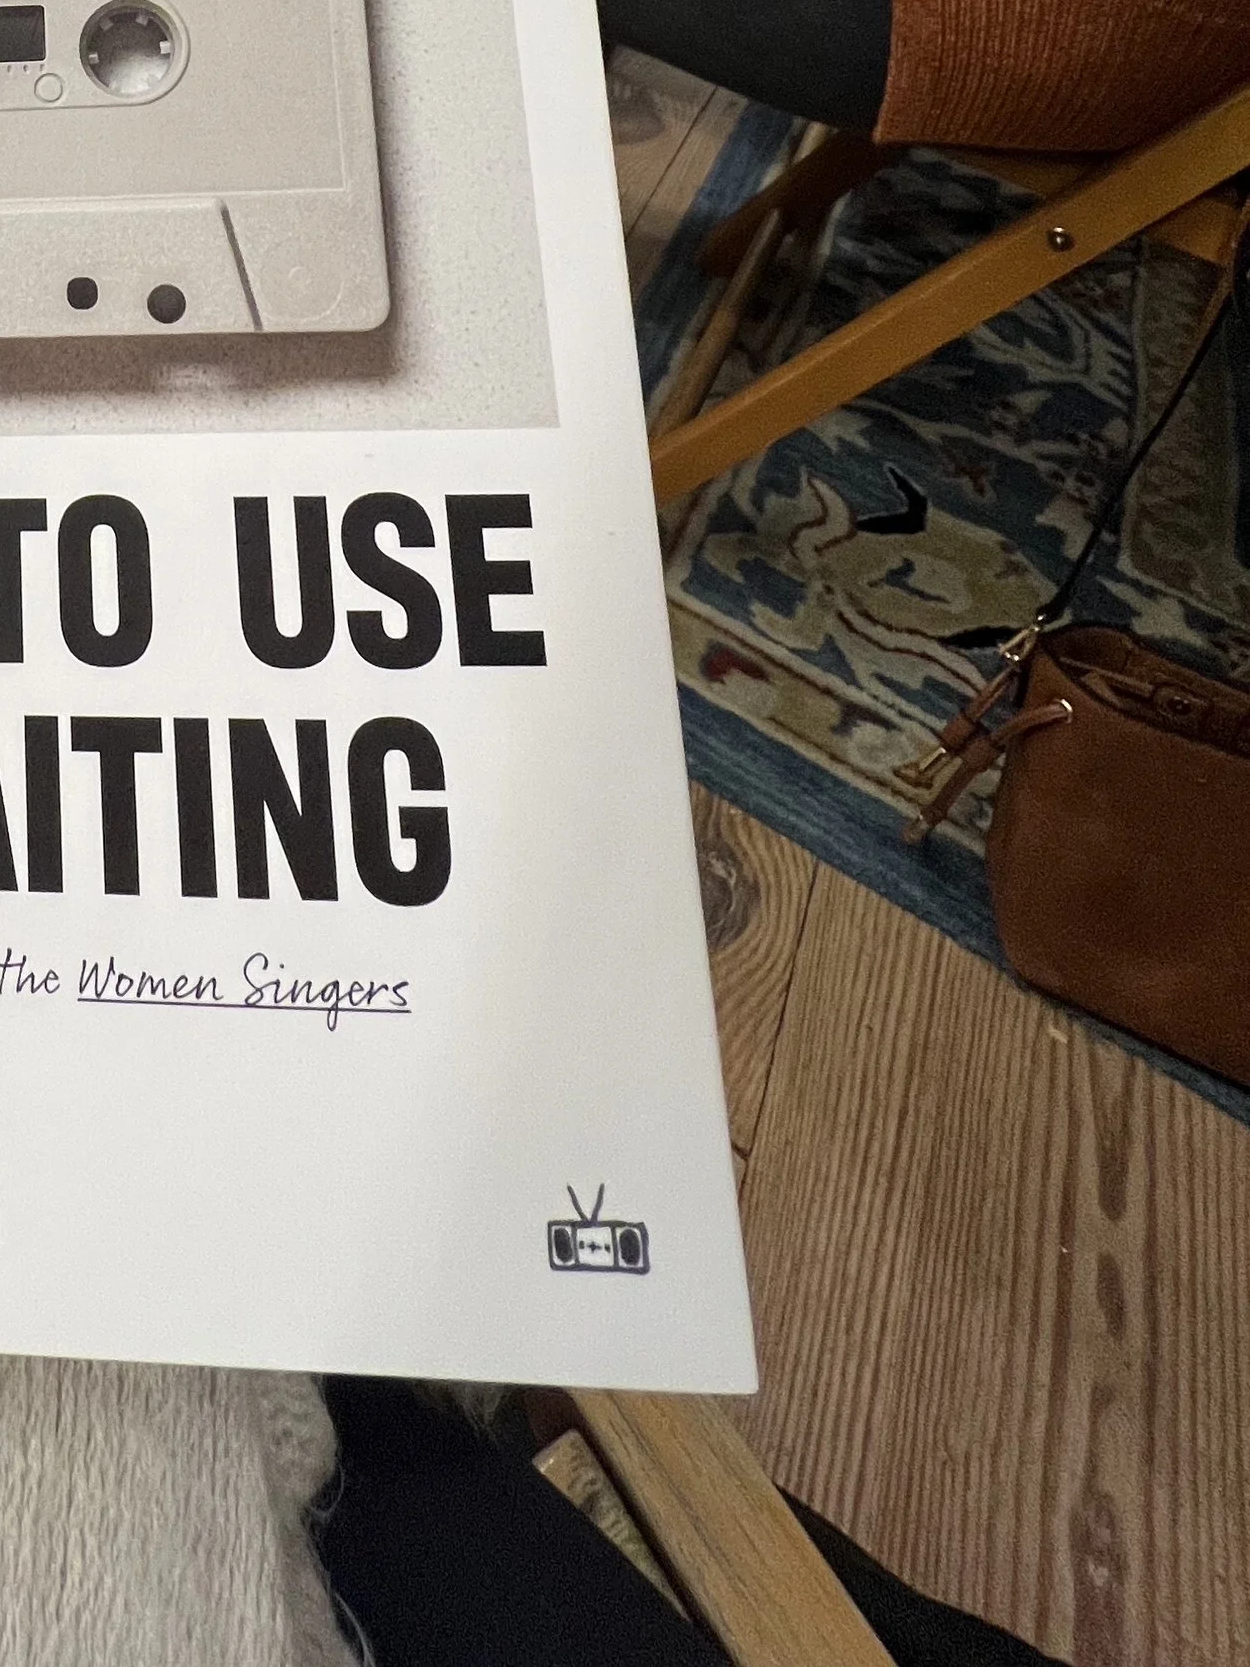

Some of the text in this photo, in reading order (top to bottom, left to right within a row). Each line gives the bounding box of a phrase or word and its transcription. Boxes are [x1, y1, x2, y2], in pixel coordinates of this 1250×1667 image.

[234, 492, 548, 670] USE
[77, 956, 225, 1008] Women
[241, 952, 412, 1032] Singers
